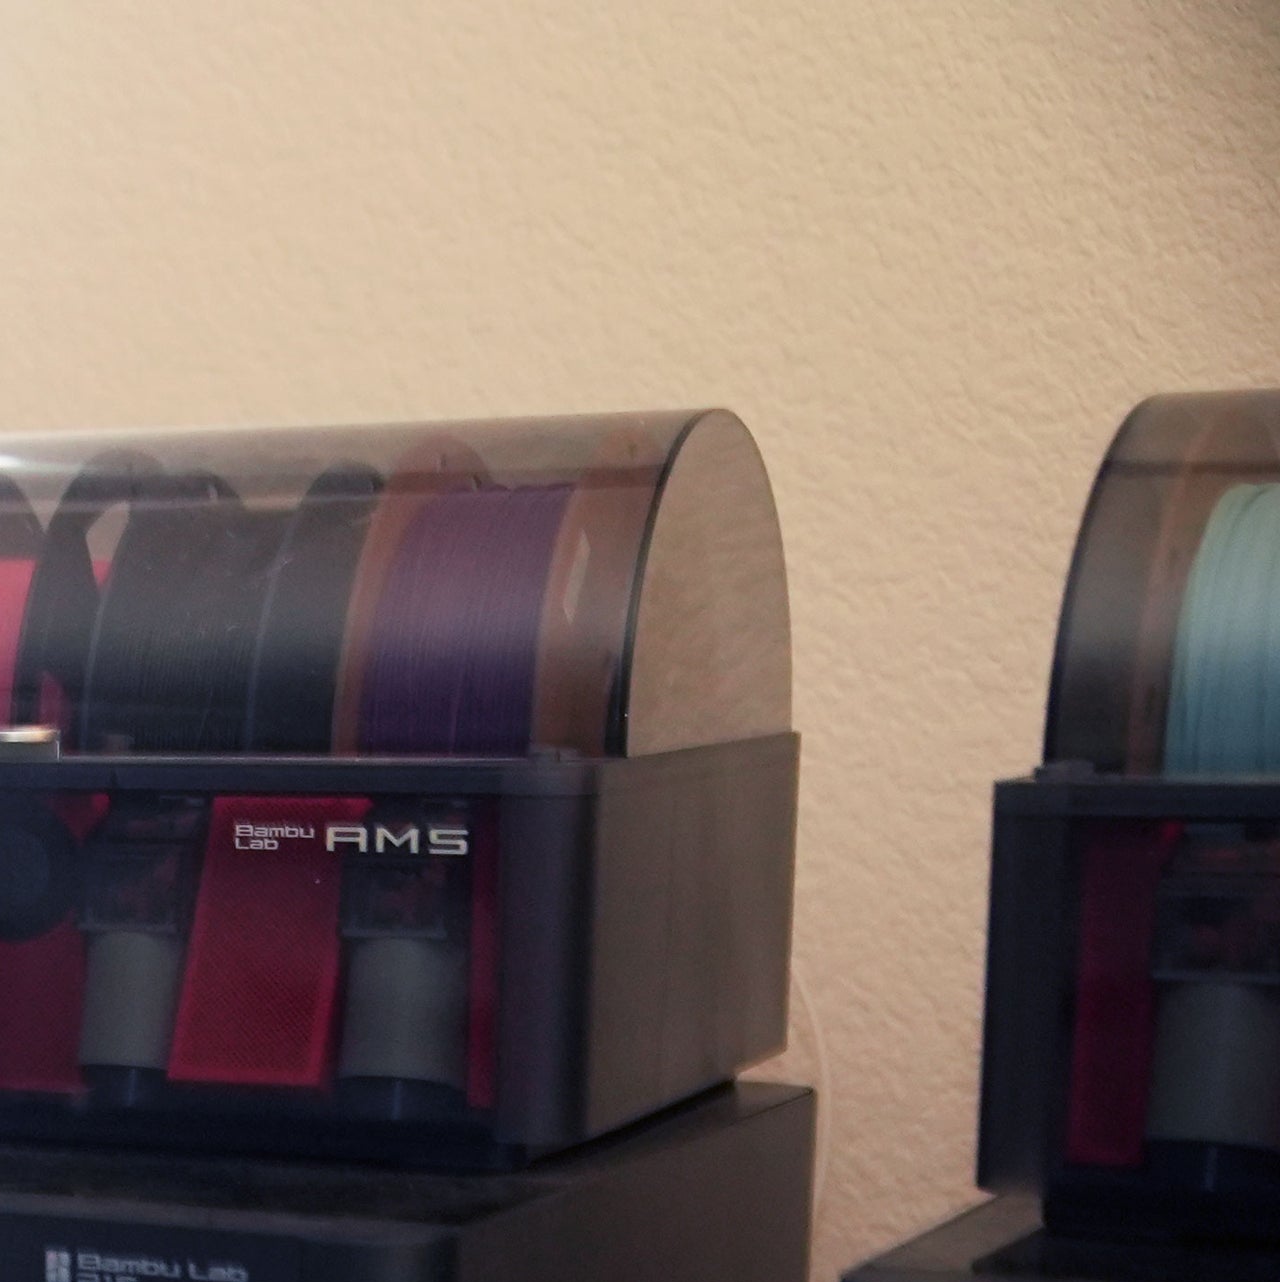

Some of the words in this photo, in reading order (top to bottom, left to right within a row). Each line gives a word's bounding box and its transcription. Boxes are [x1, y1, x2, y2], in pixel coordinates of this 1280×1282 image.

[234, 823, 315, 839] Bambu
[326, 825, 469, 856] AMS
[235, 837, 280, 851] Lab
[76, 1252, 182, 1279] Bambu
